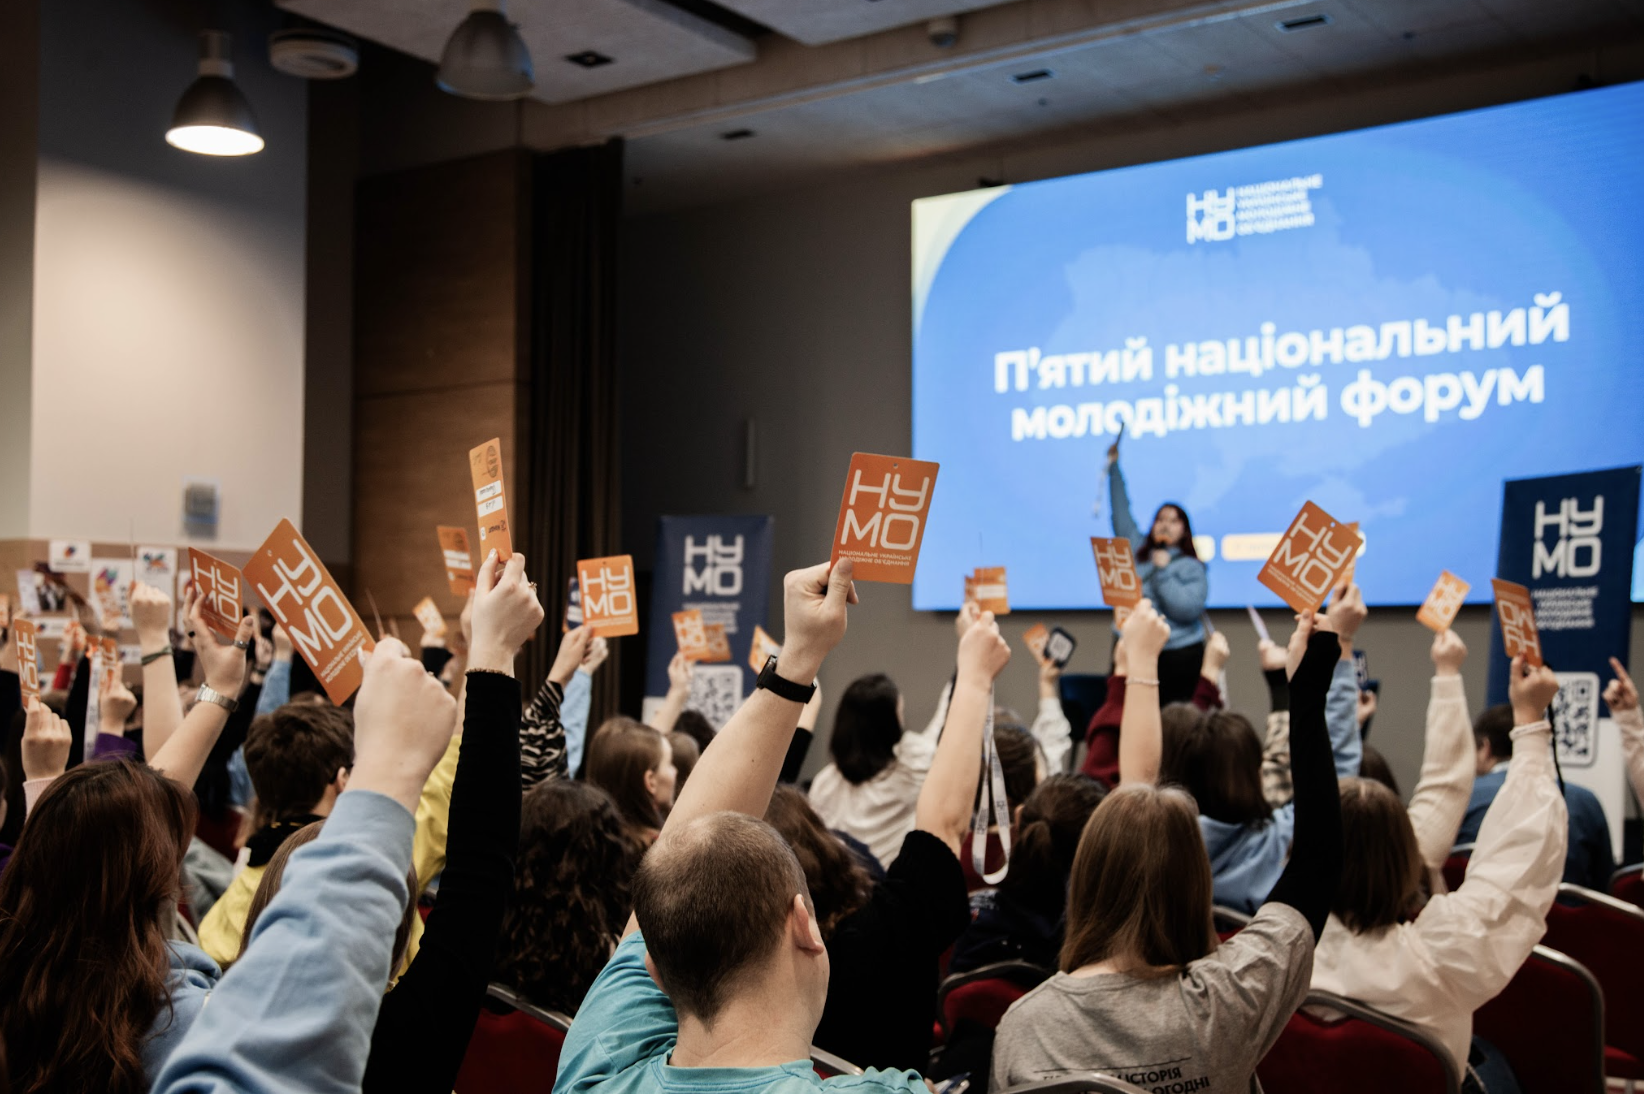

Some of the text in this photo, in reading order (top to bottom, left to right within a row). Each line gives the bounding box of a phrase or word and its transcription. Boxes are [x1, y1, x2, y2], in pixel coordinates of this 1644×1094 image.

[1186, 212, 1236, 245] МО
[994, 291, 1570, 393] П'ятий національний
[1011, 364, 1545, 441] молодіжний форум
[849, 469, 930, 512] НУ
[840, 508, 920, 551] МО
[1534, 494, 1604, 540] НУ
[684, 534, 744, 565] НУ
[1094, 544, 1132, 568] НУ
[1289, 512, 1352, 569] НУ
[1531, 536, 1602, 579] МО
[193, 557, 238, 599] НУ
[257, 538, 322, 623] НУ
[581, 565, 630, 593] НУ
[682, 564, 743, 596] МО
[1099, 566, 1136, 590] МО
[1273, 538, 1334, 595] МО
[289, 585, 353, 667] МО
[583, 590, 632, 619] МО
